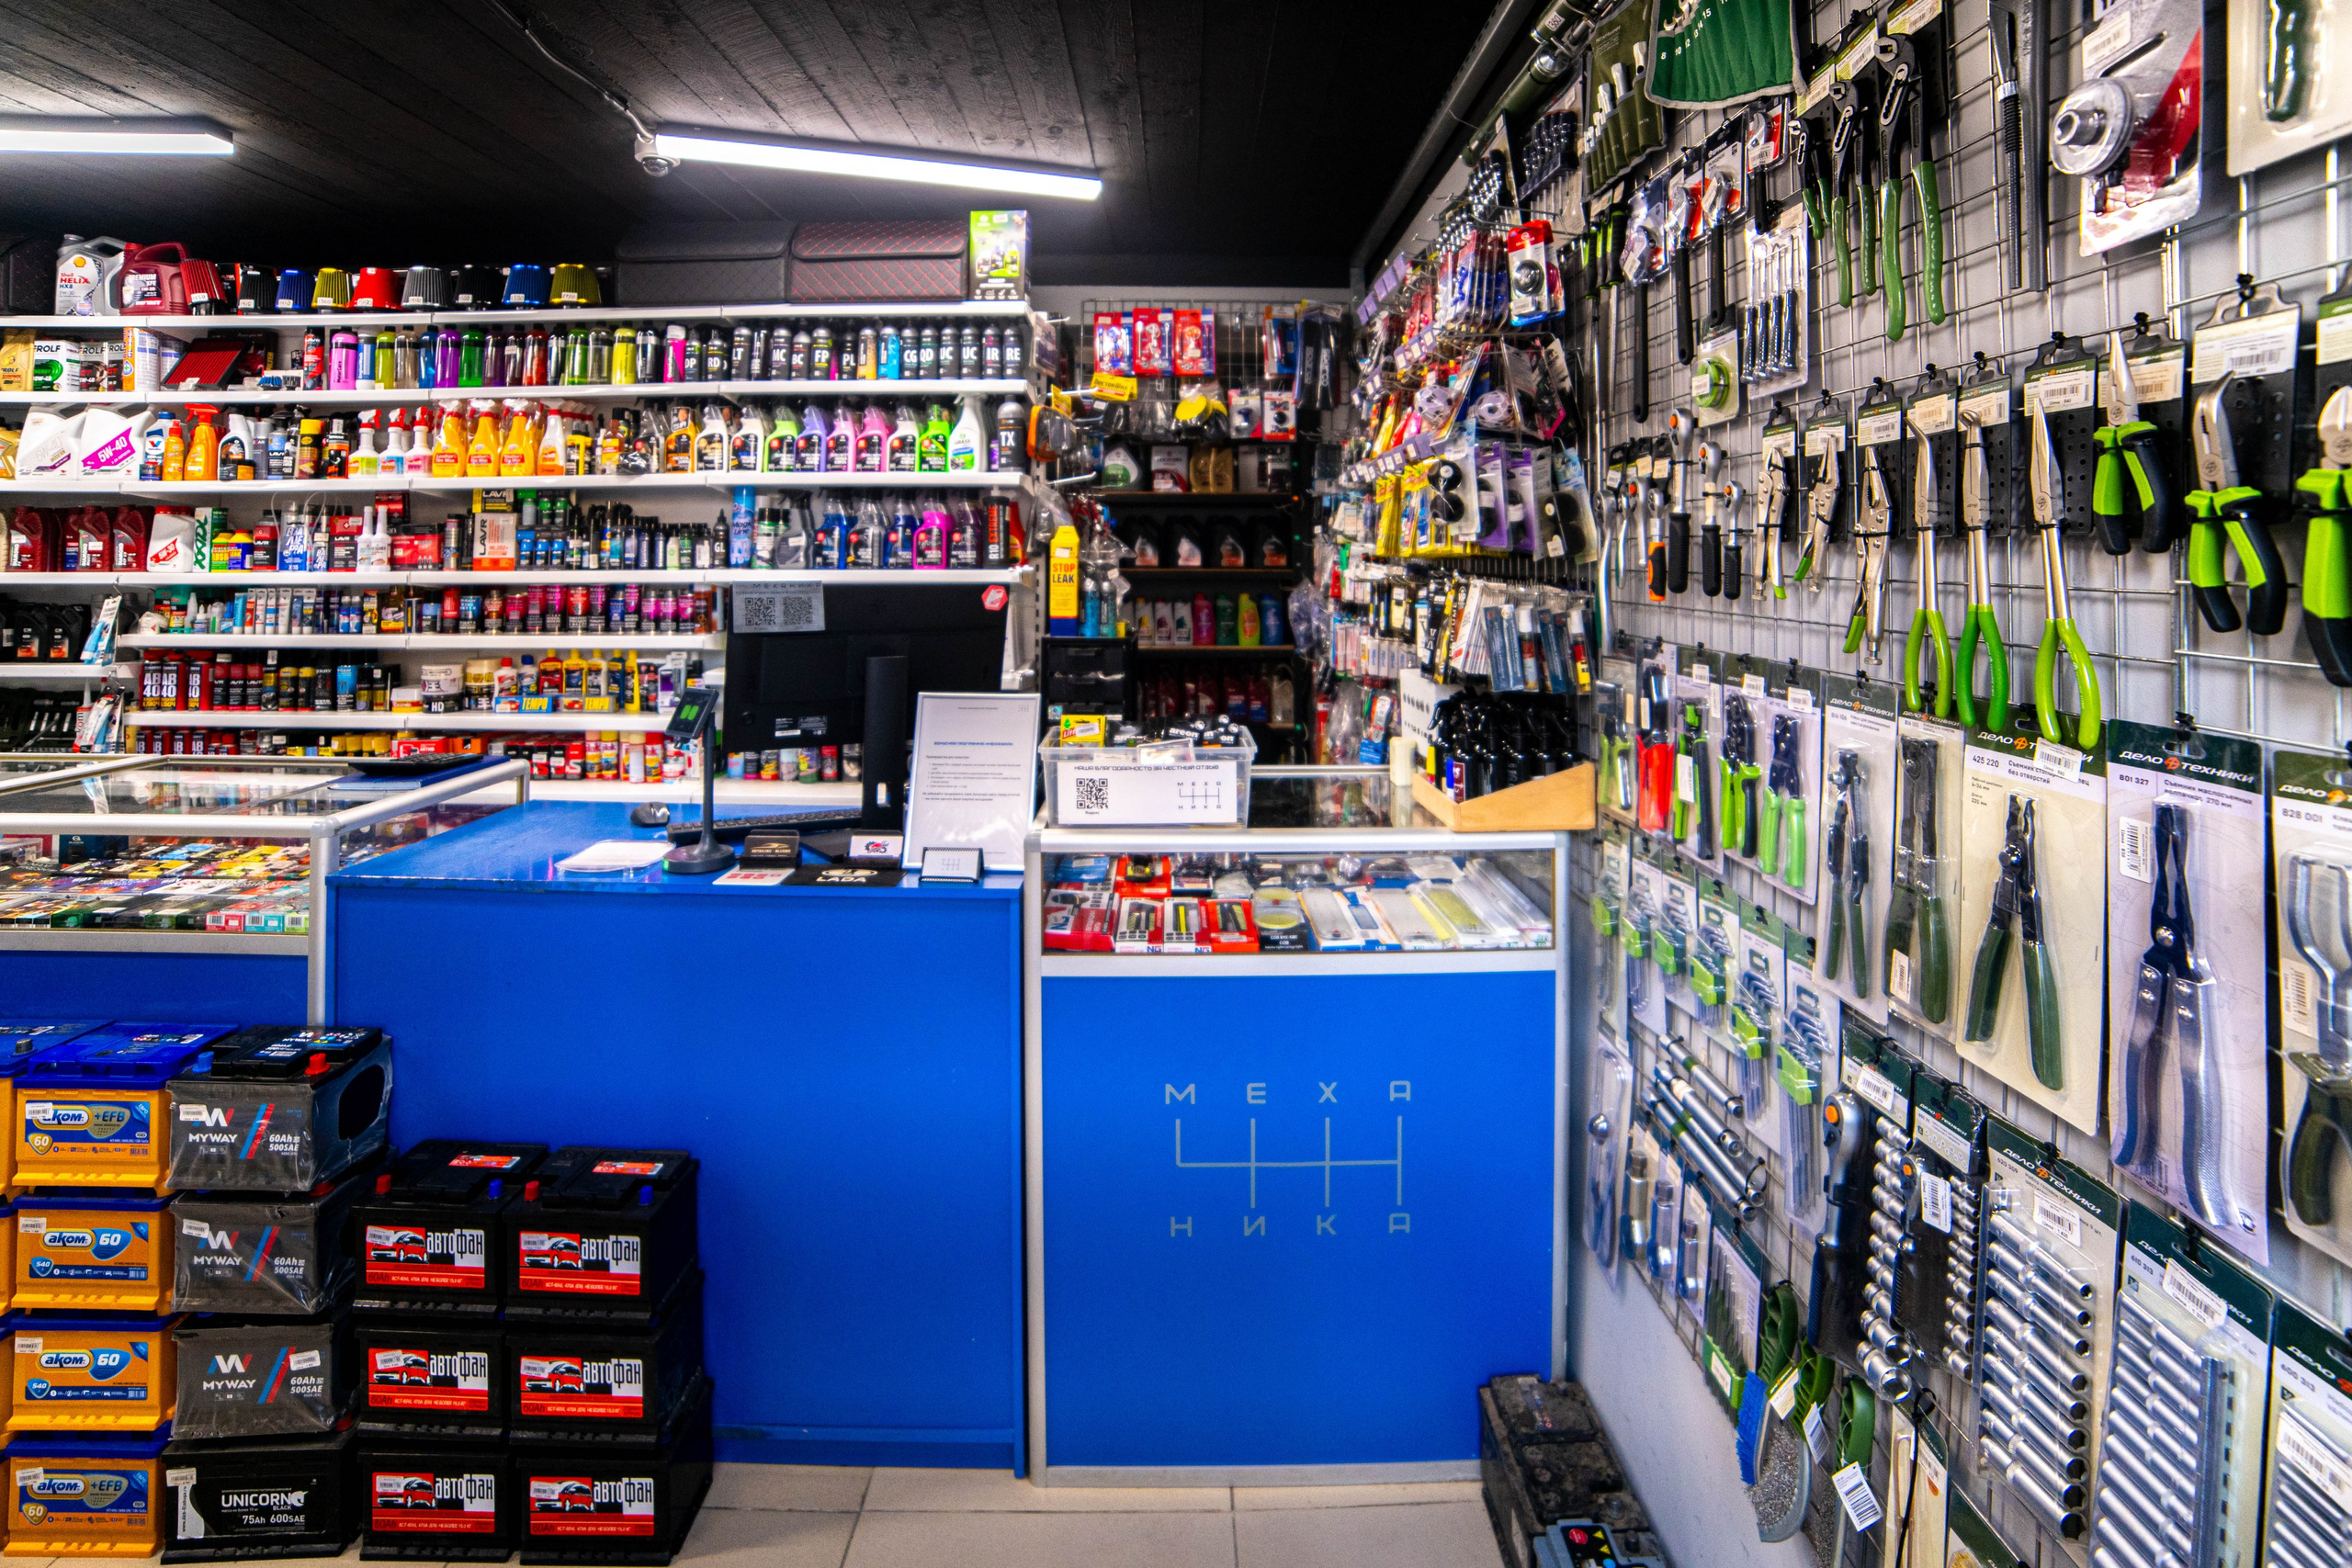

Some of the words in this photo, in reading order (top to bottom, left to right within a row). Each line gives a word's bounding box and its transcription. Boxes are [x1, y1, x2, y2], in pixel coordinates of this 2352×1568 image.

[1702, 9, 1712, 18] 15
[1675, 47, 1682, 55] 10
[773, 349, 785, 361] MC
[814, 350, 829, 362] FP
[904, 349, 917, 363] CG
[920, 347, 933, 362] QD
[963, 347, 978, 360] UC
[987, 347, 999, 360] IR
[1006, 347, 1020, 360] RE
[708, 357, 719, 367] RD
[792, 355, 803, 364] BC
[843, 355, 855, 366] PL
[1001, 432, 1014, 446] TX
[98, 436, 127, 462] 5W-40
[989, 505, 999, 542] EXTREME
[715, 542, 726, 553] GL
[1053, 563, 1075, 573] STOP
[1053, 573, 1075, 583] LEAK
[143, 685, 160, 697] 40
[432, 701, 445, 712] HD
[522, 698, 548, 709] TEMPO
[585, 698, 609, 709] TEMPO
[1830, 698, 1852, 707] дело
[1860, 705, 1894, 717] техники
[1169, 727, 1199, 739] areon
[1977, 732, 2014, 744] дело
[1973, 755, 1984, 764] 425
[1986, 758, 1999, 768] 220
[2008, 761, 2034, 772] Съемник
[2119, 750, 2163, 764] дело
[2182, 762, 2255, 783] техники
[2019, 773, 2051, 784] отверстий
[2119, 774, 2133, 784] 801
[2134, 777, 2149, 786] 327
[2165, 779, 2196, 792] Съемник
[2279, 784, 2326, 797] дело
[2207, 797, 2220, 806] 270
[1147, 945, 1162, 953] NG
[95, 1111, 126, 1122] +EFB
[34, 1136, 50, 1146] 60
[189, 1134, 238, 1143] MYWAY
[269, 1134, 292, 1143] 60Ah
[269, 1144, 300, 1152] 500SAE
[1997, 1157, 2007, 1168] 620
[2008, 1165, 2018, 1174] 309
[2003, 1148, 2035, 1169] дело
[2049, 1176, 2102, 1214] техники
[99, 1234, 121, 1246] 60
[426, 1229, 483, 1258] автофан
[581, 1236, 639, 1266] автофан
[193, 1255, 243, 1266] MYWAY
[274, 1257, 299, 1266] 60Ah
[274, 1267, 303, 1275] 500SAE
[97, 1354, 119, 1365] 60
[2288, 1345, 2335, 1380] дело
[430, 1352, 487, 1382] автофан
[582, 1359, 641, 1389] автофан
[203, 1380, 255, 1391] MYWAY
[290, 1377, 316, 1385] 60Ah
[290, 1385, 323, 1393] 500SAE
[371, 1395, 392, 1404] 60Ah
[524, 1404, 546, 1413] 60Ah
[91, 1480, 123, 1492] +EFB
[435, 1474, 493, 1504] автофан
[594, 1478, 652, 1507] автофан
[220, 1493, 291, 1507] UNICORN
[28, 1506, 43, 1516] 60
[243, 1515, 266, 1525] 75Ah
[270, 1514, 305, 1523] 600SAE
